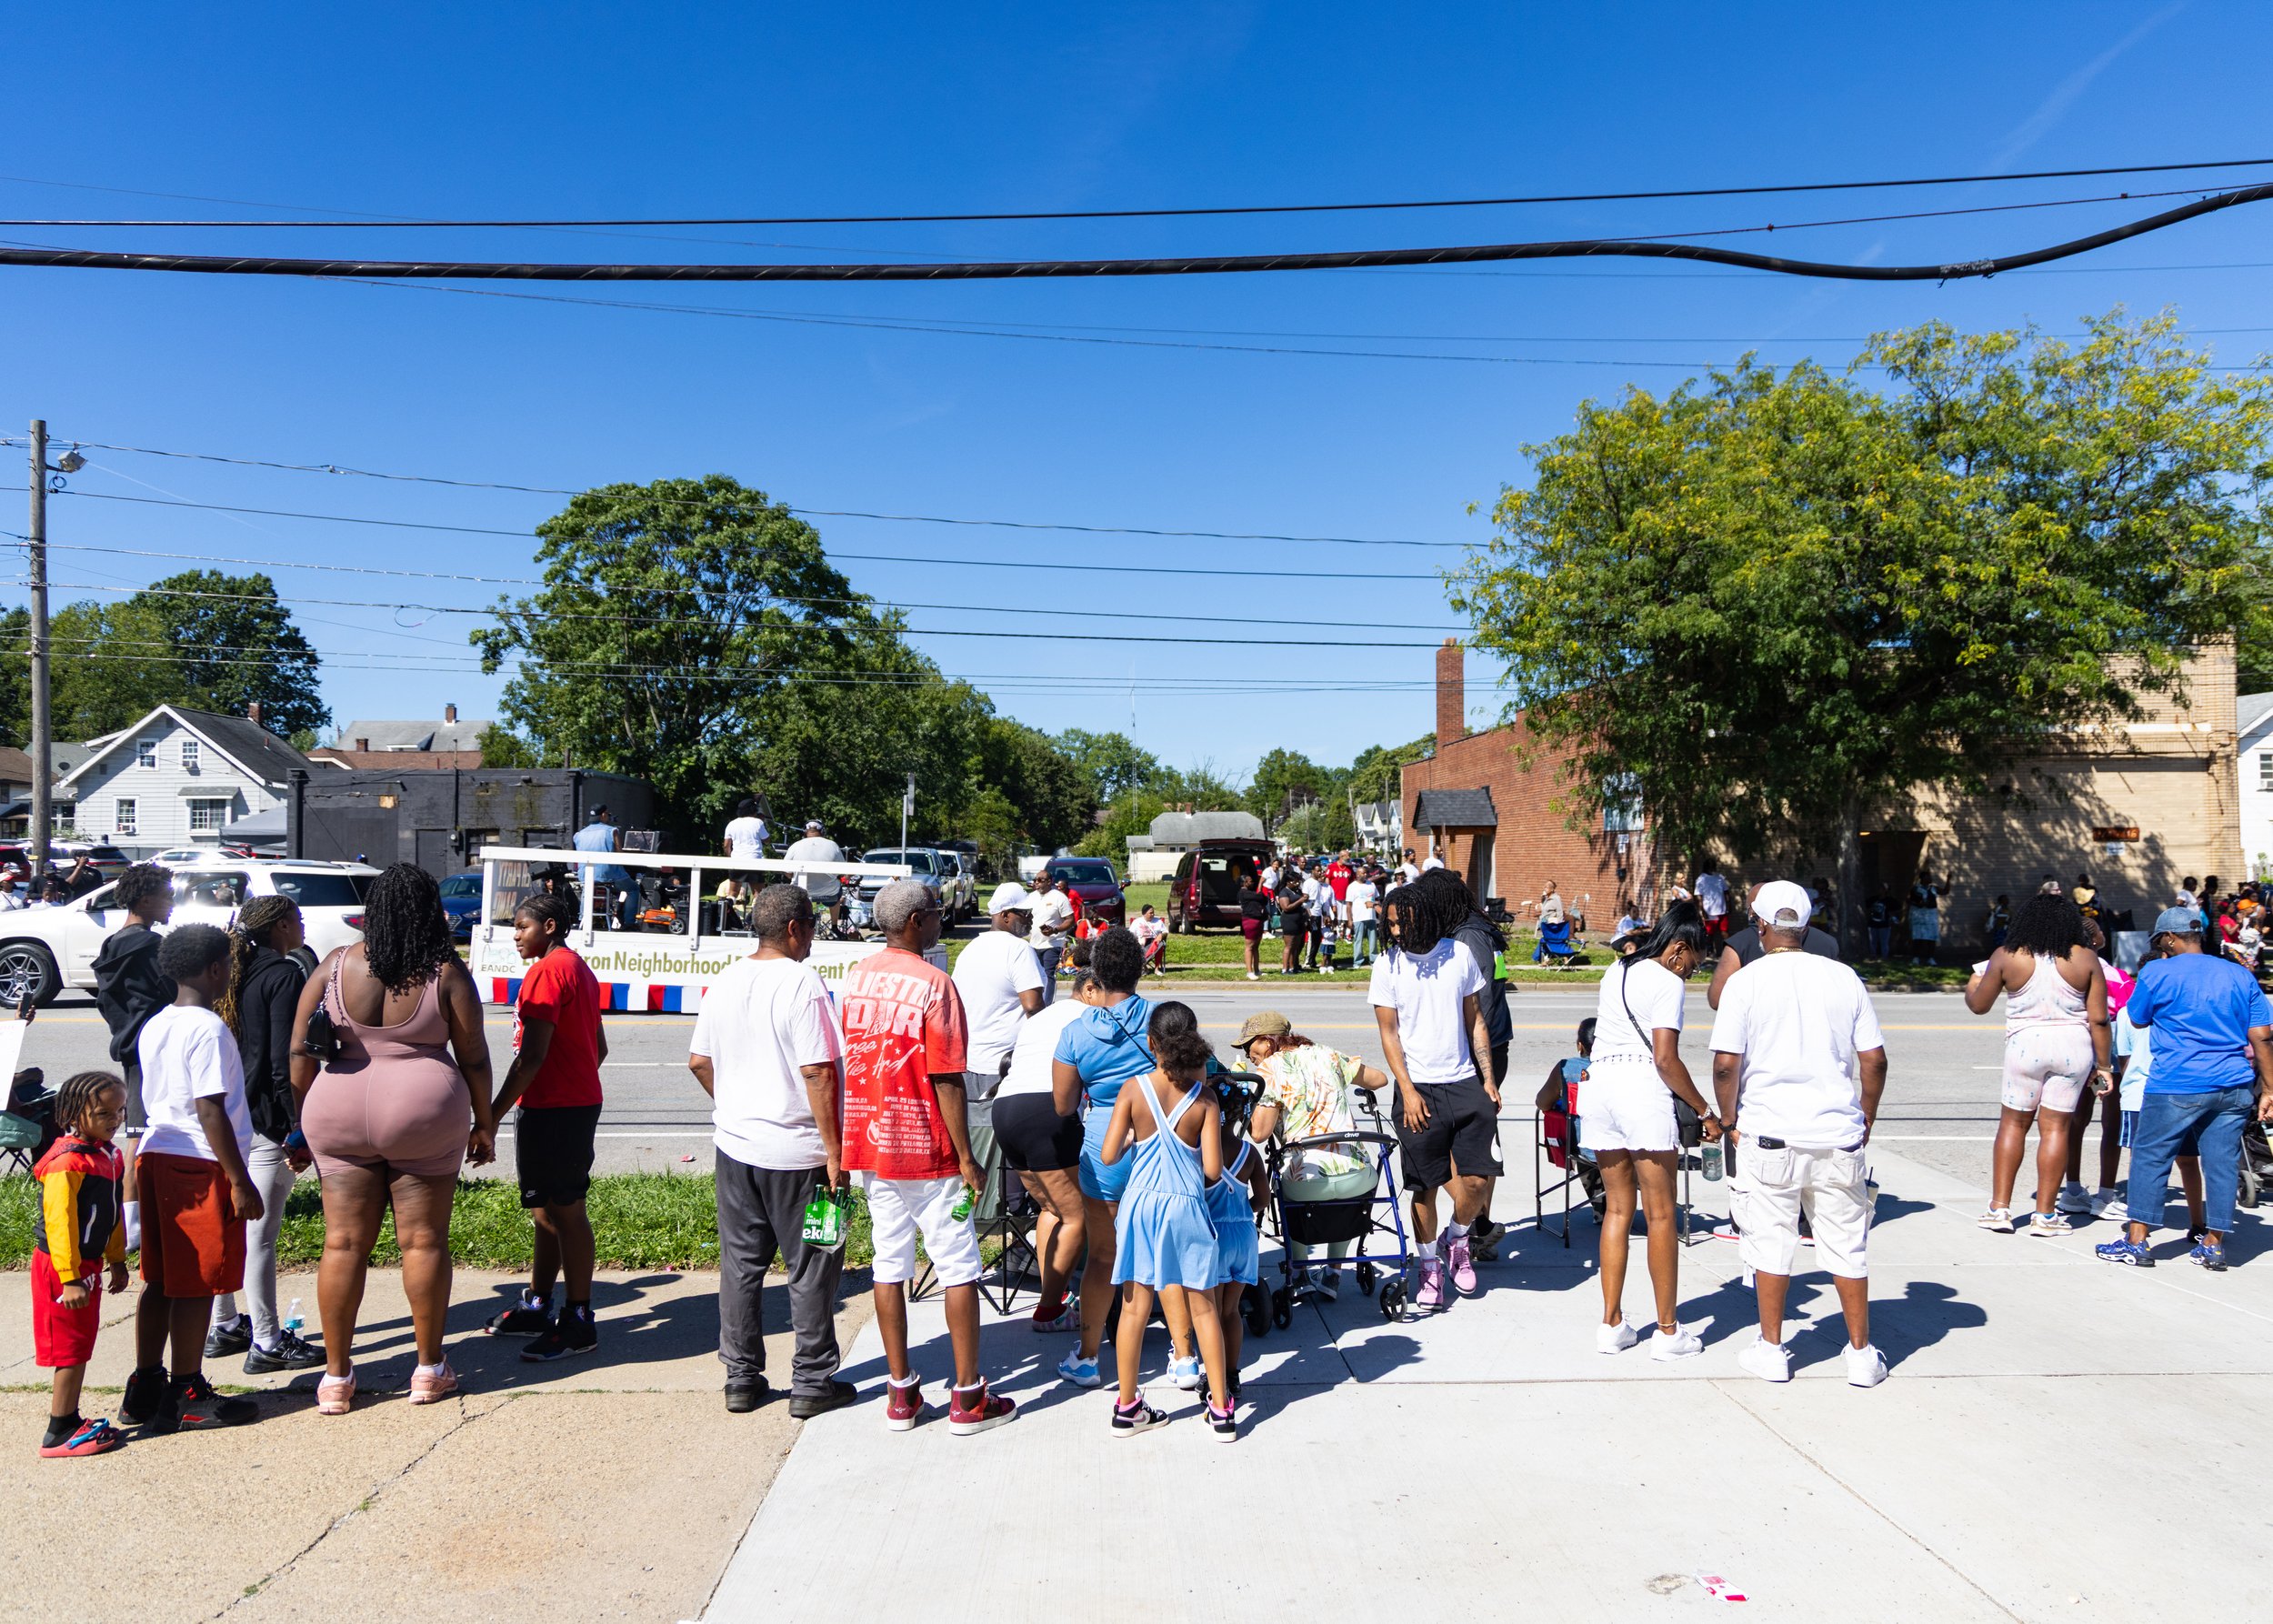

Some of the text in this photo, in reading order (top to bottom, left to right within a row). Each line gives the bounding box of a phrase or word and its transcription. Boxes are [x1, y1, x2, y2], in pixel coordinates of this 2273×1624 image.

[481, 964, 516, 974] EANDC
[806, 1218, 822, 1226] mini
[803, 1226, 836, 1242] ek
